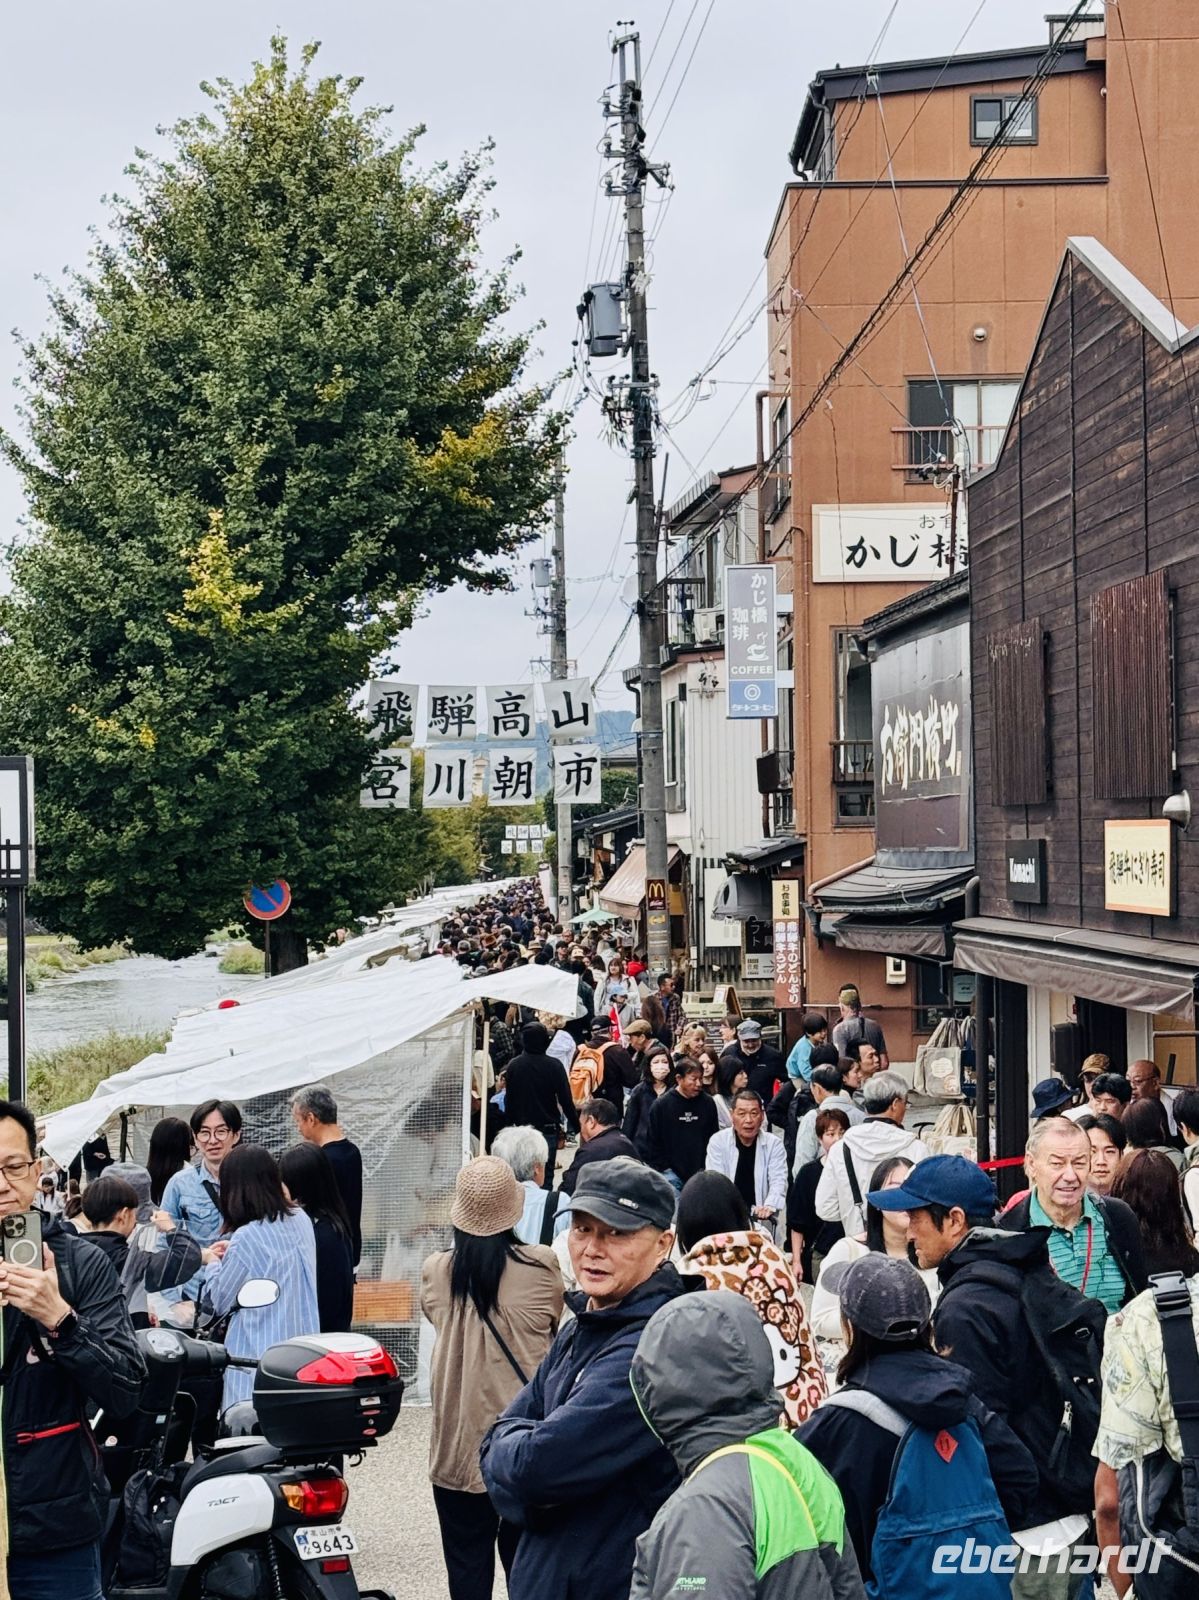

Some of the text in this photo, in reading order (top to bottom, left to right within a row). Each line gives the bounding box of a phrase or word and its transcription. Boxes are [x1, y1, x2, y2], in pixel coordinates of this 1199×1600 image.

[845, 533, 969, 569] かじ橋
[750, 572, 768, 624] かじ橋
[731, 607, 749, 641] 珈琲
[731, 665, 774, 675] COFFEE
[370, 690, 589, 738] 飛騨高山
[366, 752, 598, 801] 宮川朝市
[1009, 857, 1036, 883] Komachi
[1109, 849, 1165, 888] 飛騨牛にぎり寿司
[207, 1495, 240, 1508] TACT
[312, 1534, 354, 1554] 9643
